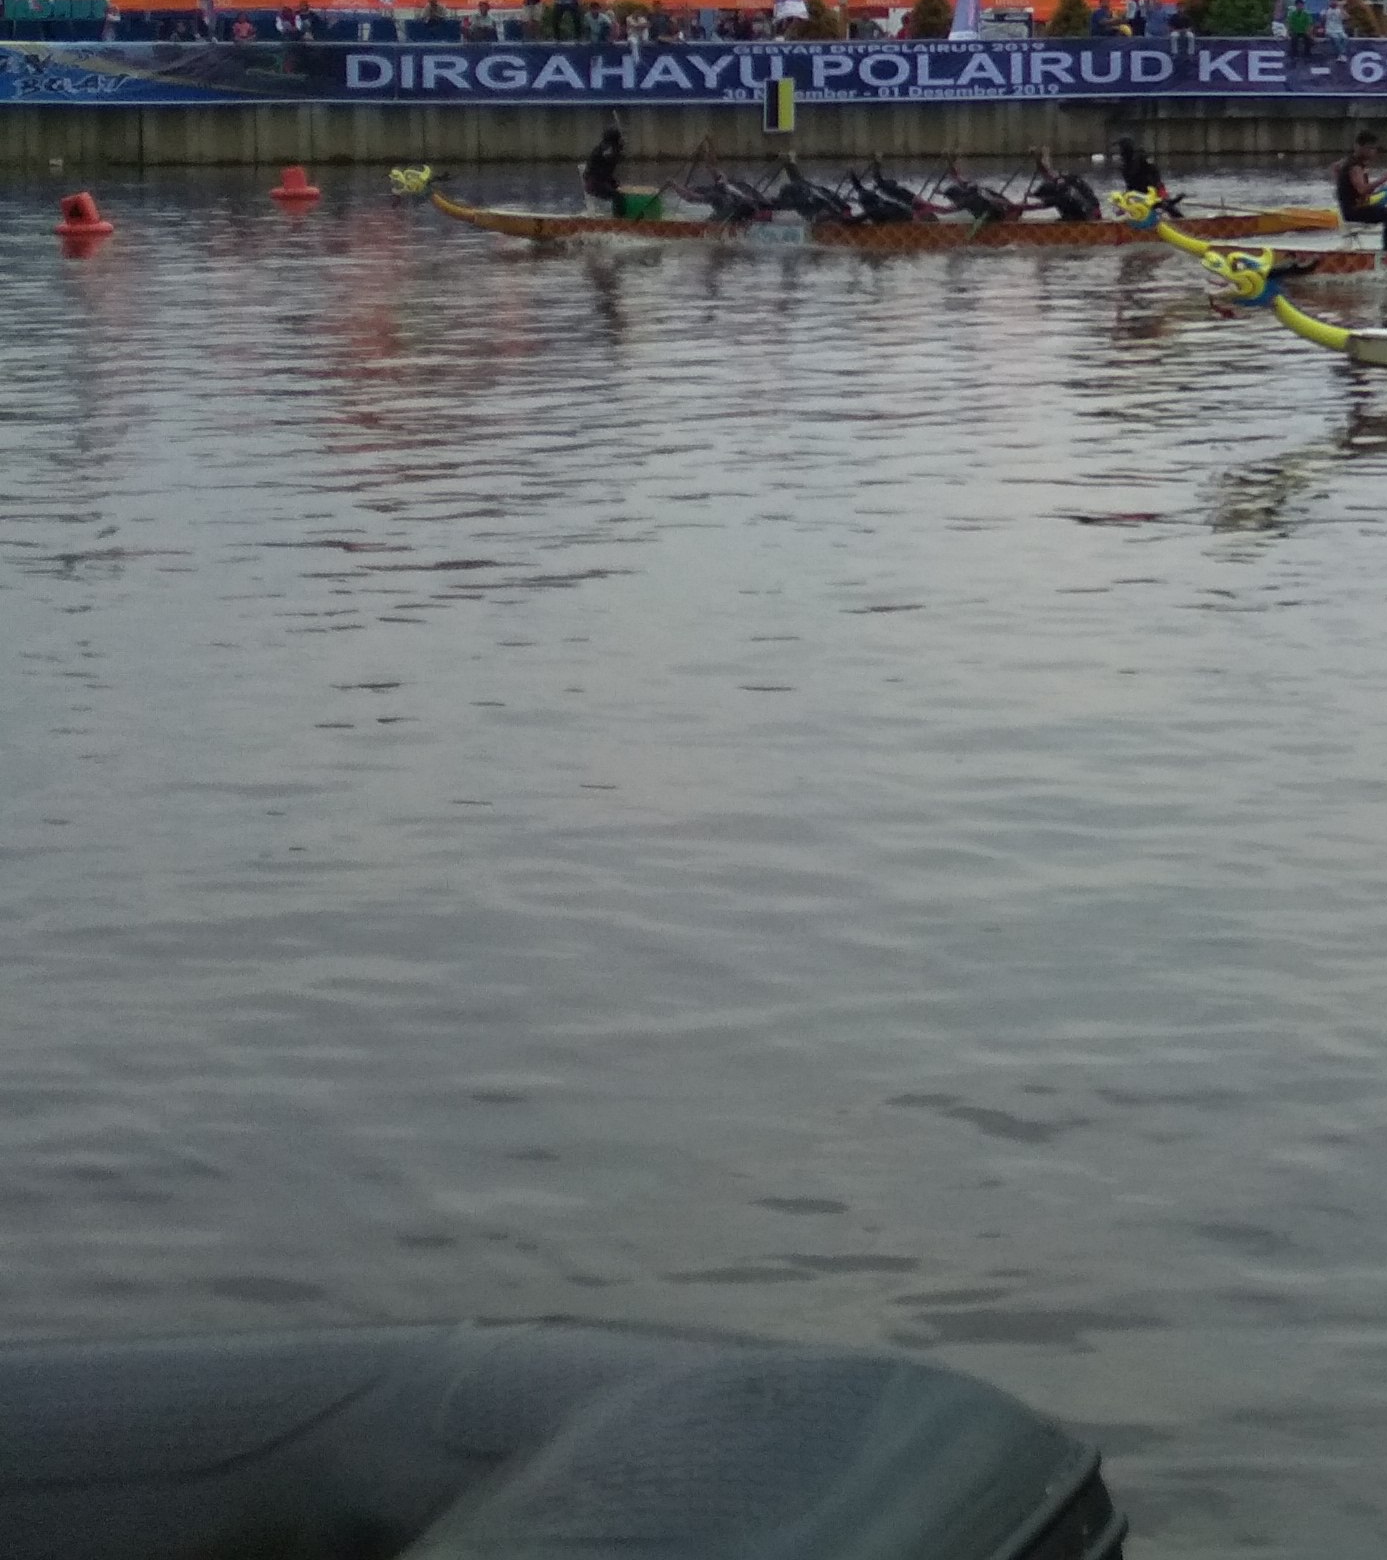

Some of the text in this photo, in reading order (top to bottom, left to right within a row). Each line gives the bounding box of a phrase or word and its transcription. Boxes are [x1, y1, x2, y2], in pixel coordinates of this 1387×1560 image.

[733, 42, 1046, 55] GEBYAR DITPOLAIRUD 2019
[346, 53, 784, 89] DIRGAHAYU
[812, 50, 1174, 88] POLAIRUD
[1199, 50, 1286, 82] KE
[723, 88, 746, 100] 30
[753, 87, 857, 100] Nember
[877, 87, 899, 98] 01
[909, 85, 1006, 98] Desember
[1012, 83, 1060, 96] 2019
